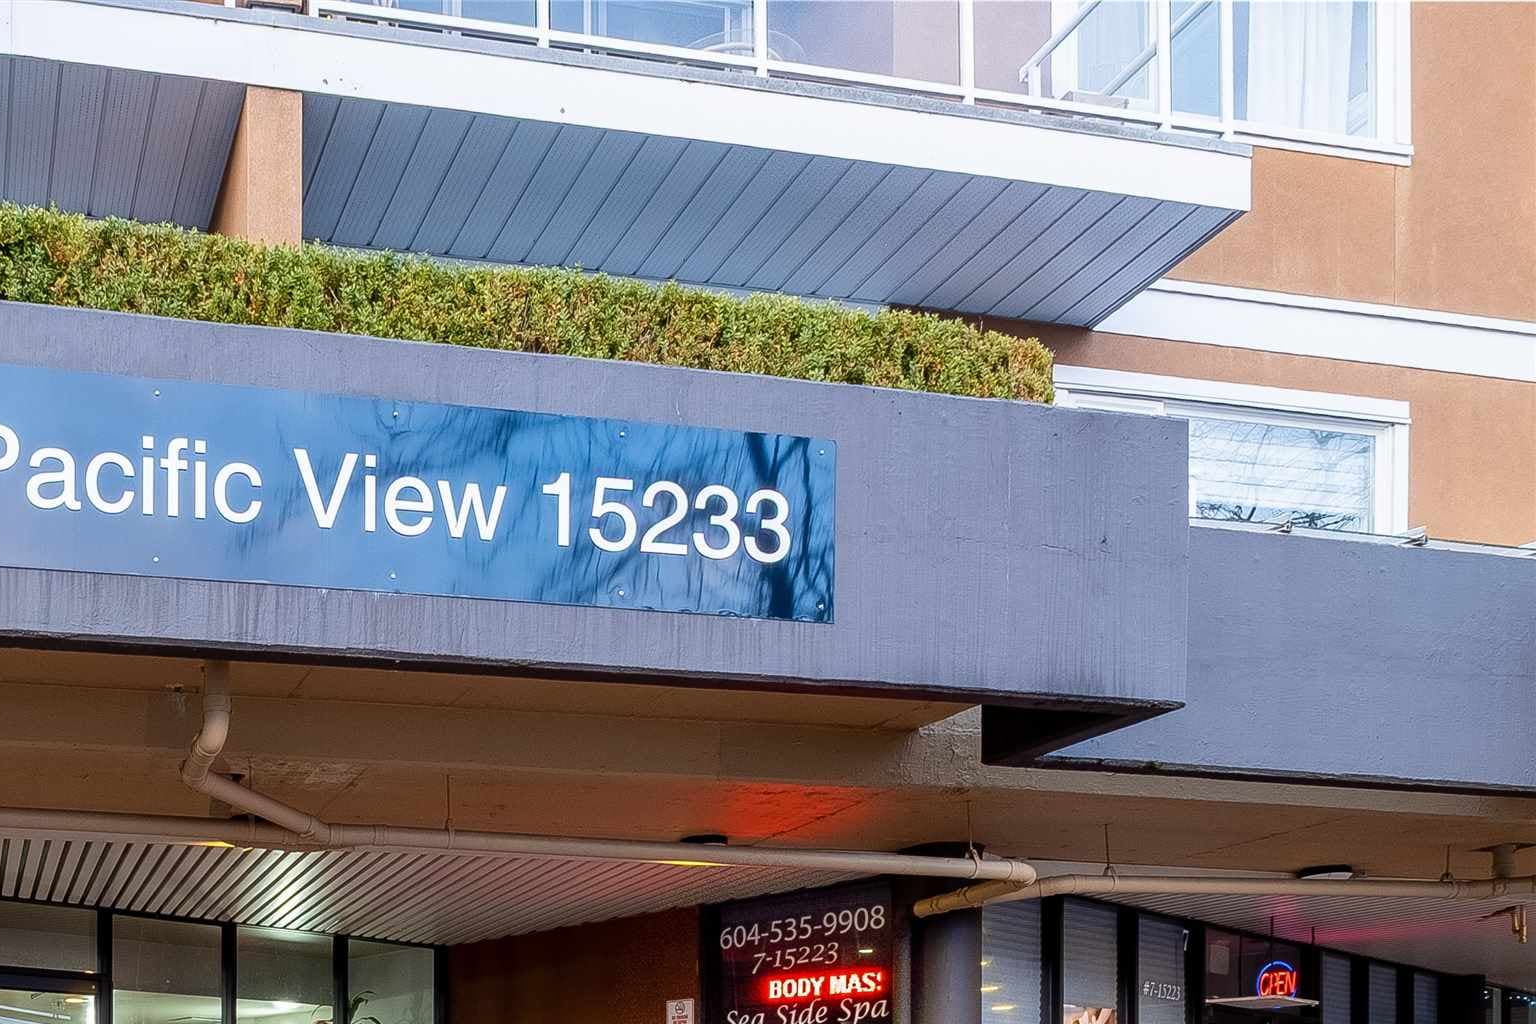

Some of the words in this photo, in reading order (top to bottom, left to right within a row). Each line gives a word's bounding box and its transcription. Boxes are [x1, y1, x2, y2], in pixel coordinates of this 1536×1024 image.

[292, 447, 507, 541] View
[543, 472, 792, 565] 15233
[720, 905, 885, 950] 604-535-9908
[751, 942, 839, 975] 7-15223
[768, 976, 825, 999] BODY
[1143, 980, 1181, 1001] #7-15223
[1260, 971, 1297, 996] OPEN
